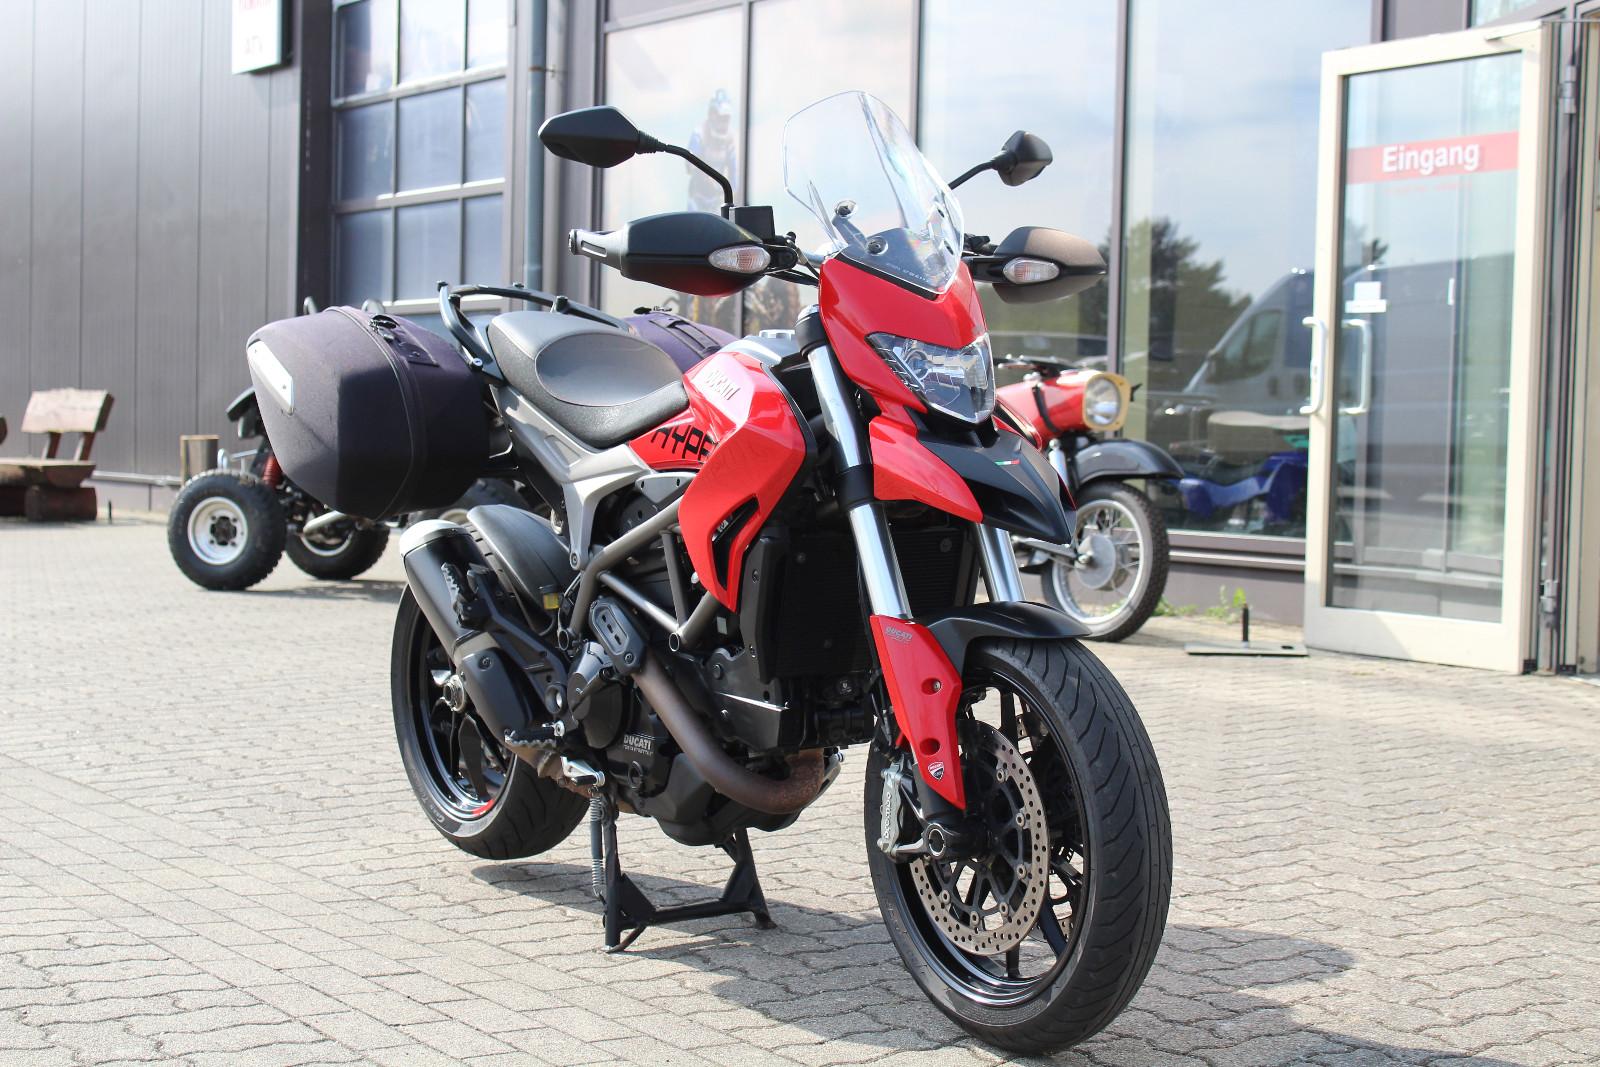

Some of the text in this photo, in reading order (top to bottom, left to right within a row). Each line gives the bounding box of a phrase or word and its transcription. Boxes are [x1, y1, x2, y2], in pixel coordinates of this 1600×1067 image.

[1382, 143, 1480, 175] Eingang
[623, 734, 652, 750] DUCATI
[884, 791, 892, 839] brembo
